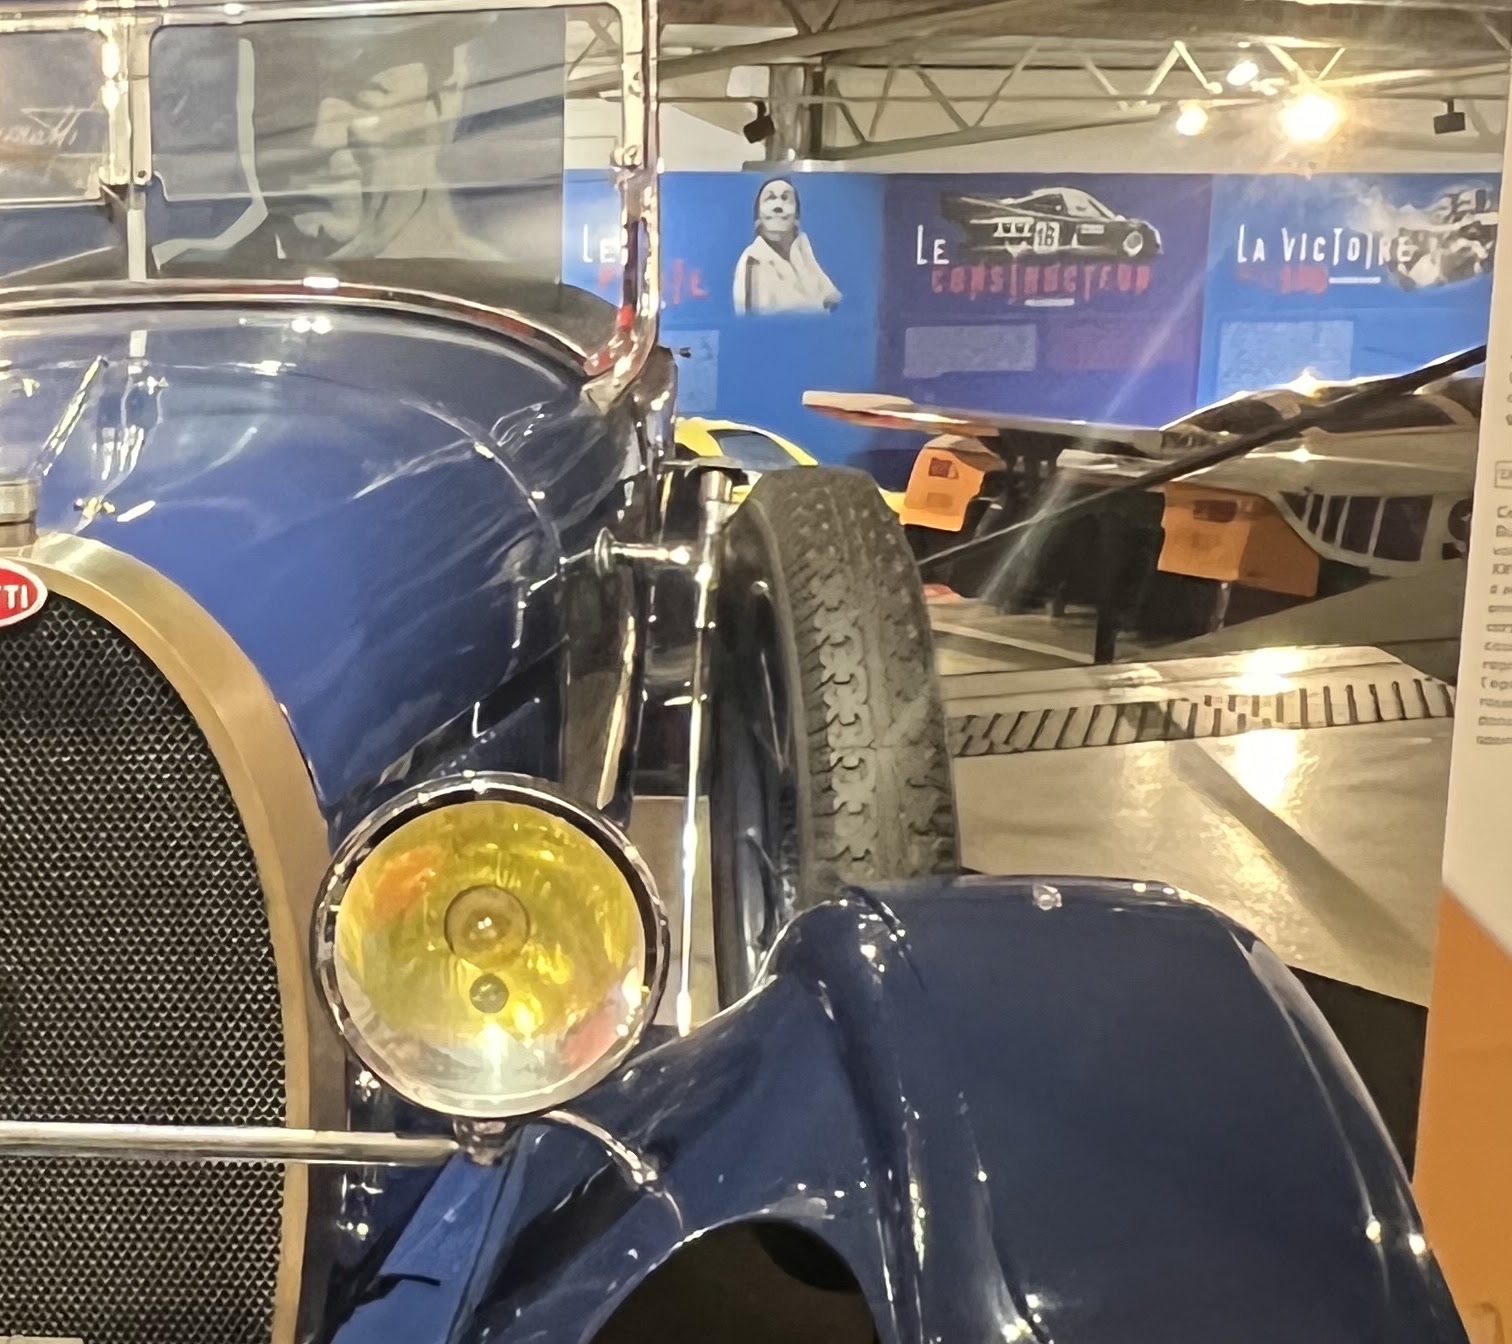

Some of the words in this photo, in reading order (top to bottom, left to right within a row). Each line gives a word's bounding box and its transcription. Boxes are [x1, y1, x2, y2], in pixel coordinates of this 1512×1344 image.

[916, 224, 950, 265] LE
[1237, 223, 1266, 264] LA
[1281, 226, 1412, 270] VICTOIRE
